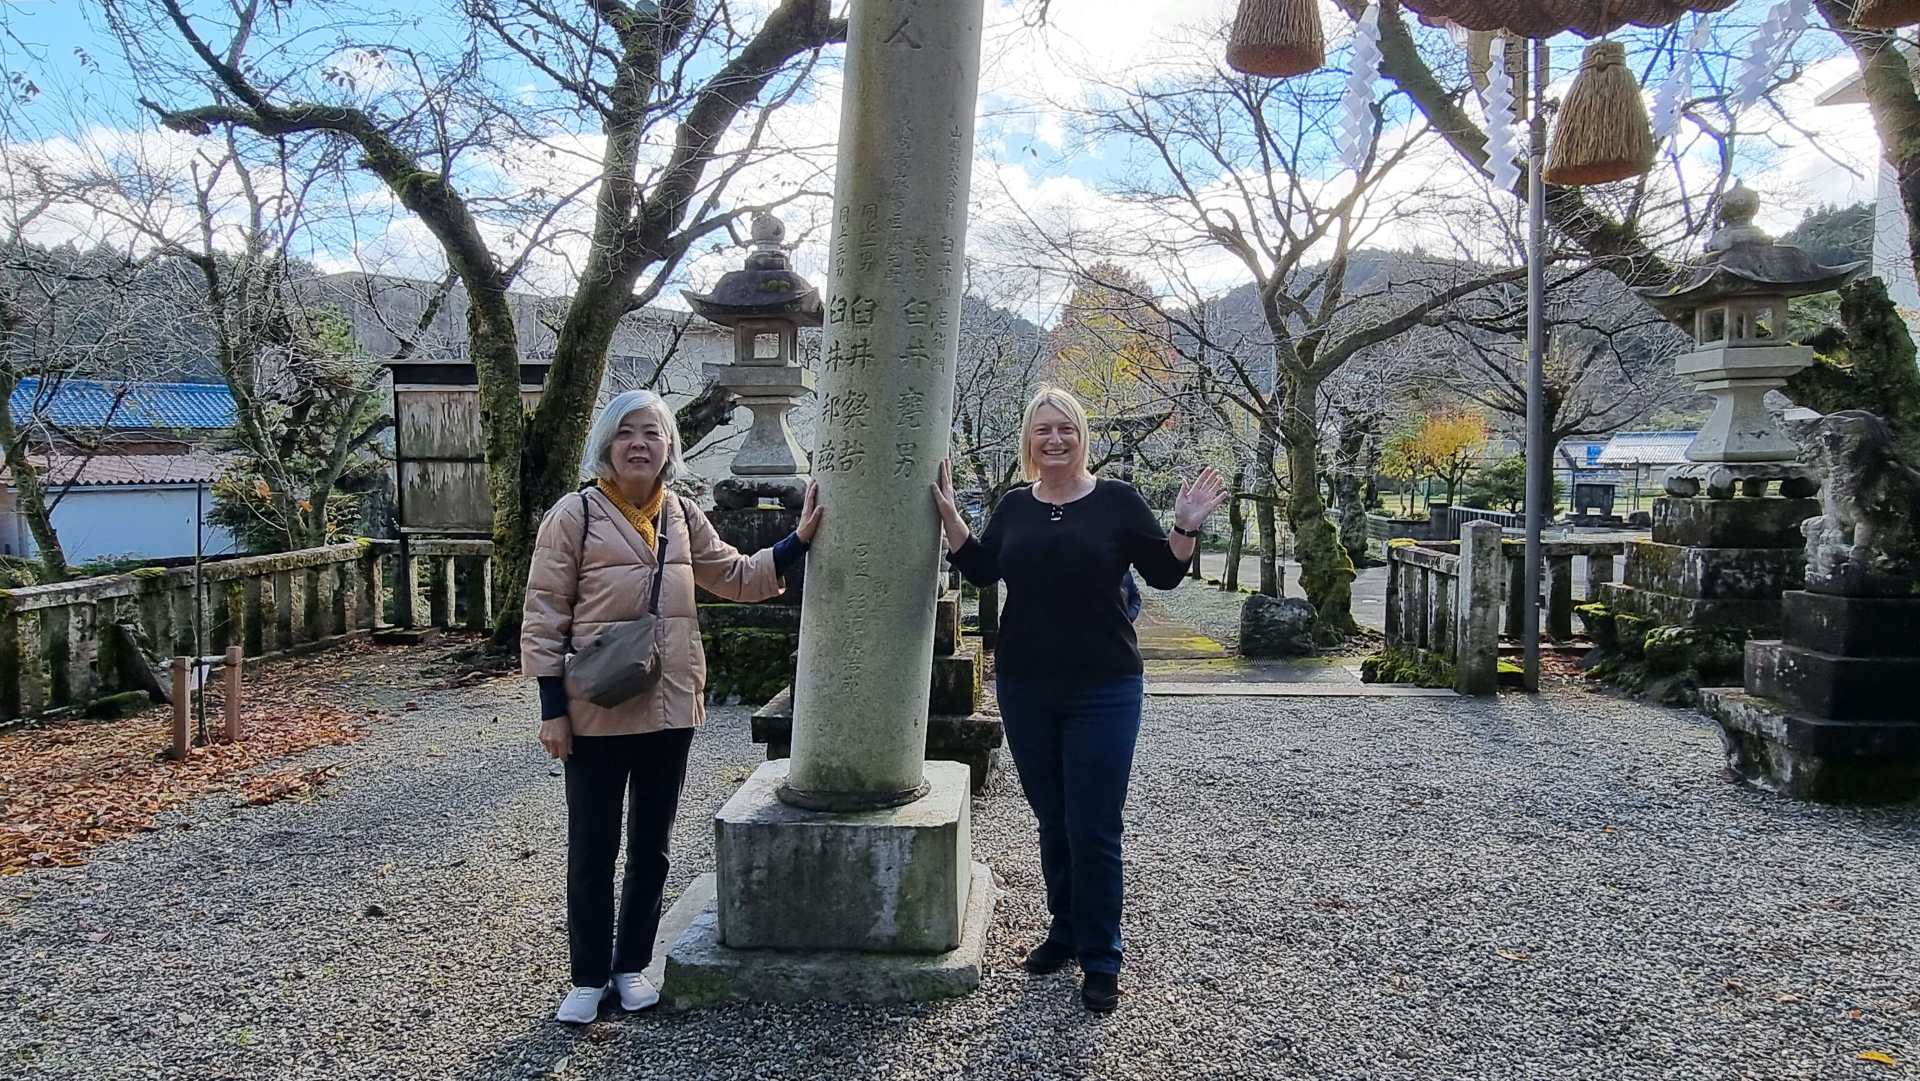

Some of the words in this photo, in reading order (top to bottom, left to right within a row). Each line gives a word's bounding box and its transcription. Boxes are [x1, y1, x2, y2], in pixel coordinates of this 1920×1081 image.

[883, 16, 922, 50] 人
[858, 202, 879, 272] 同上二男
